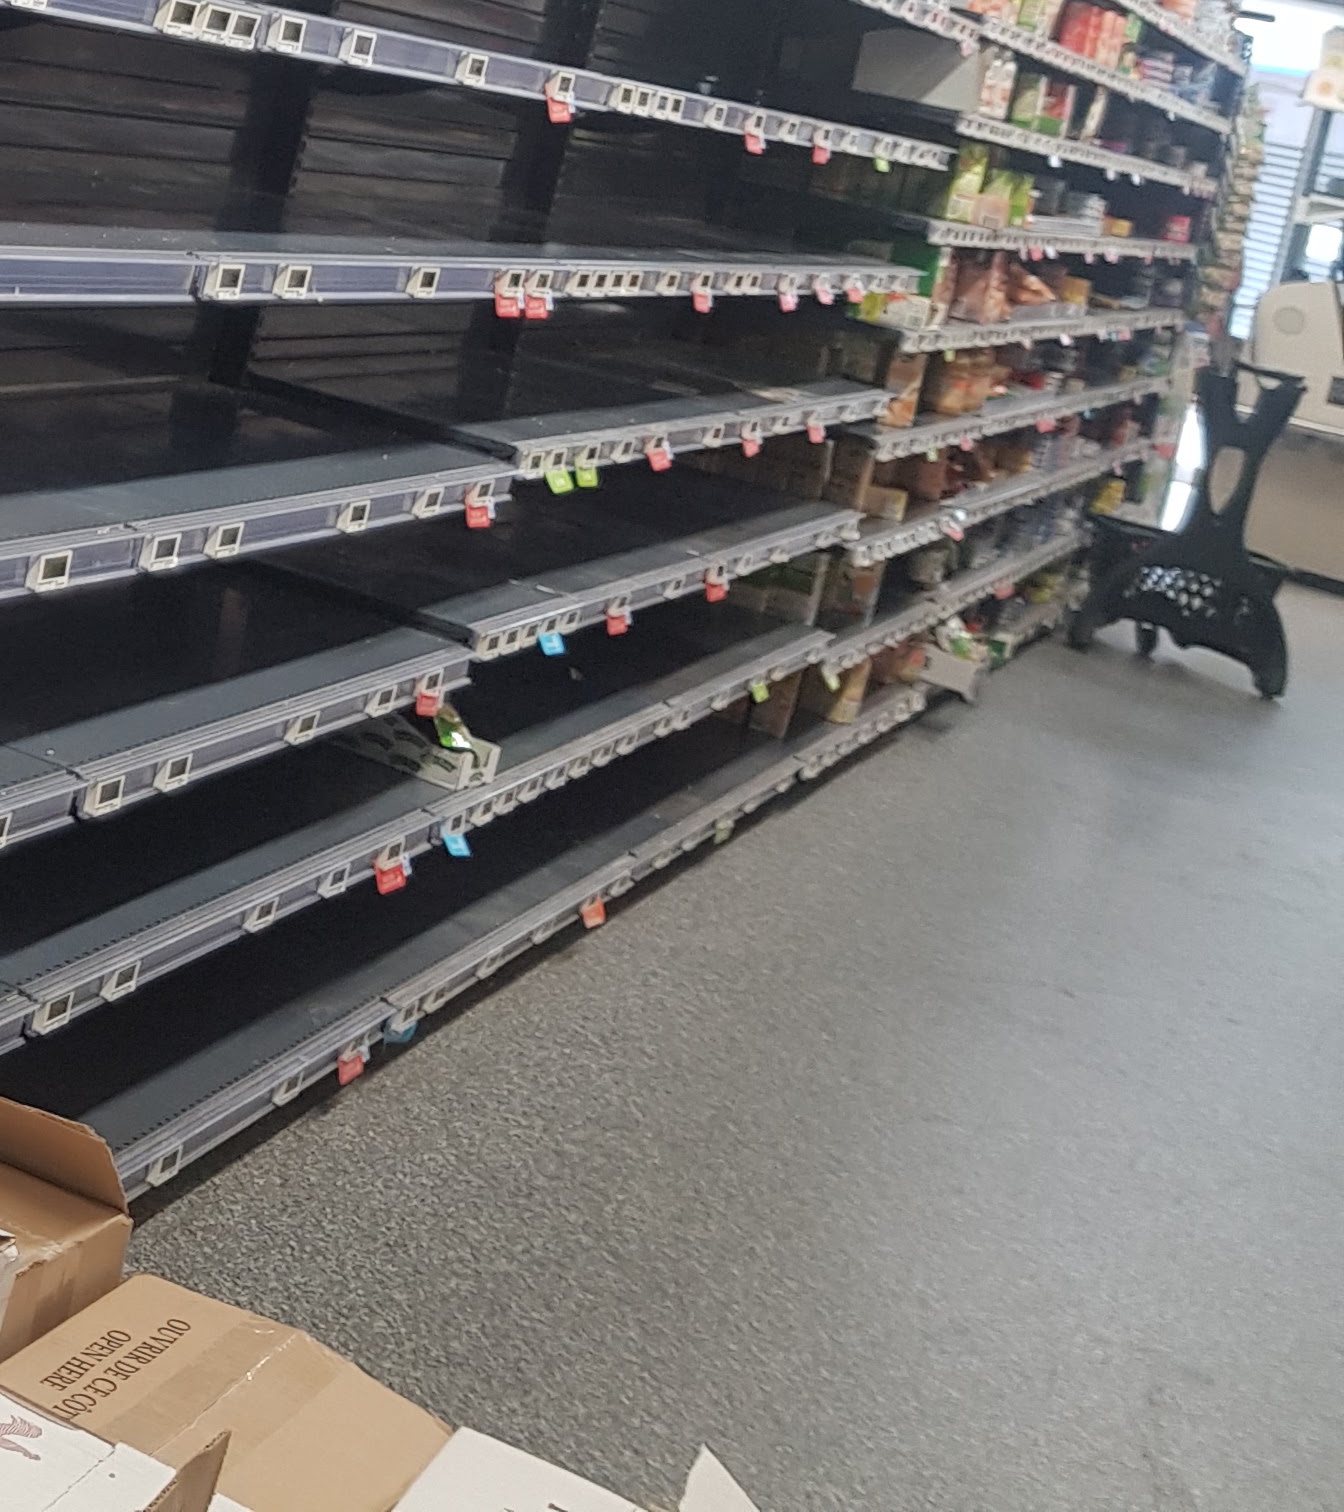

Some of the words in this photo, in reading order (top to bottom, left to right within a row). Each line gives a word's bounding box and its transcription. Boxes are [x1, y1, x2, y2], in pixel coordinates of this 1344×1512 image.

[80, 1330, 132, 1362] OPEN
[123, 1318, 192, 1365] OUVRIR
[40, 1356, 95, 1392] HERE
[103, 1360, 141, 1381] DE
[83, 1377, 118, 1398] CE
[52, 1393, 97, 1421] CÔT
